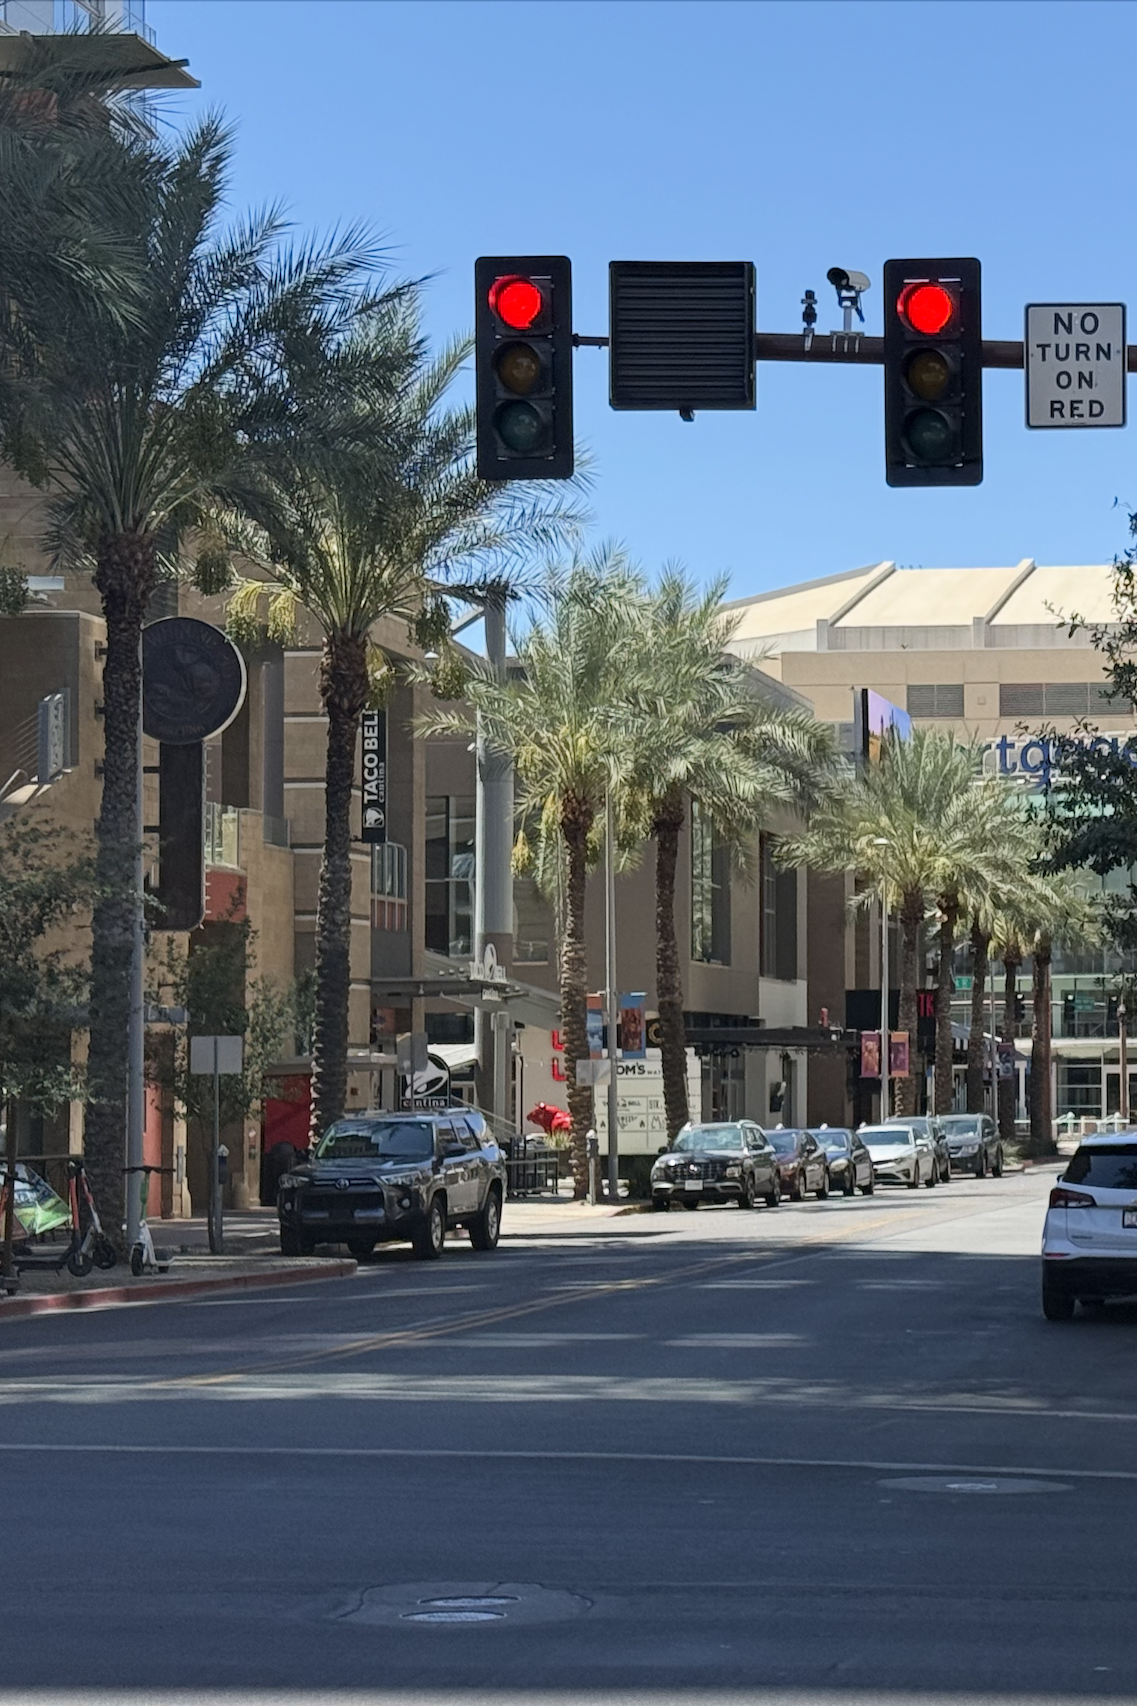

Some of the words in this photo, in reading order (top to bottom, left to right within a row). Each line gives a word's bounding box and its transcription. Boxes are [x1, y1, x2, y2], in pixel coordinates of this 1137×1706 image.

[1053, 312, 1099, 335] NO
[1036, 342, 1112, 362] TURN
[1056, 371, 1093, 389] ON
[1050, 400, 1104, 418] RED
[363, 753, 379, 804] TACO
[616, 1062, 646, 1075] OM'S
[403, 1098, 447, 1108] cntina
